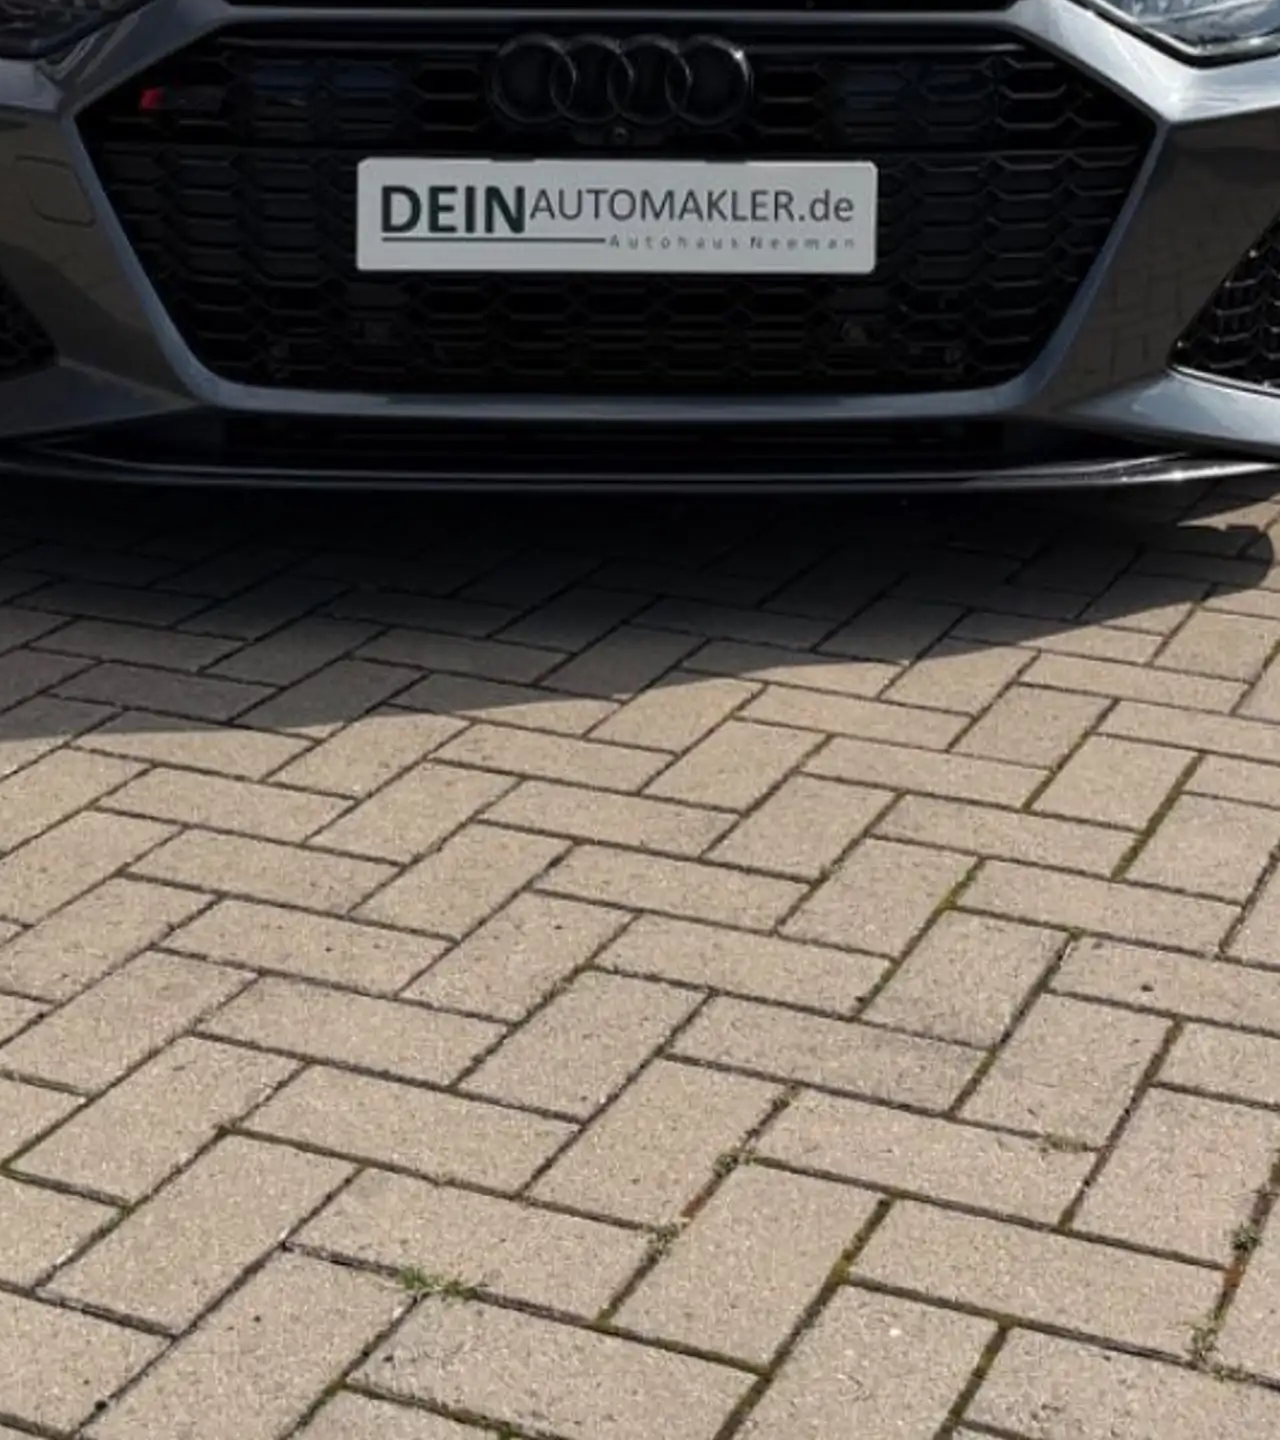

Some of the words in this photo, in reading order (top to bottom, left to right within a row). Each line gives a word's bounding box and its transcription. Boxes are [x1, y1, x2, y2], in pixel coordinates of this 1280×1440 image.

[380, 184, 855, 235] DEINAUTOMAKLER.de
[608, 233, 740, 250] Autohaus
[750, 235, 856, 250] Neeman
